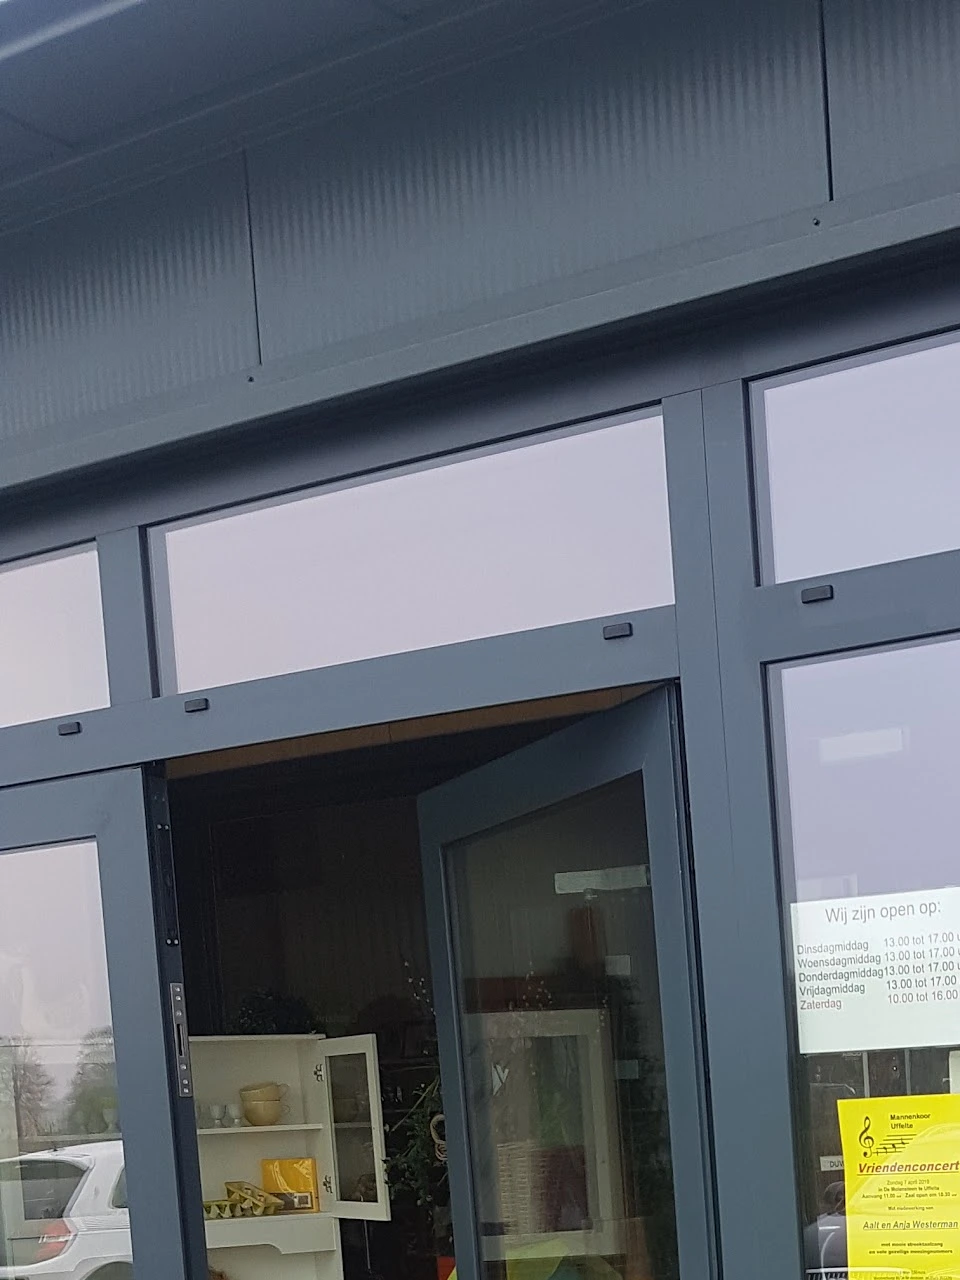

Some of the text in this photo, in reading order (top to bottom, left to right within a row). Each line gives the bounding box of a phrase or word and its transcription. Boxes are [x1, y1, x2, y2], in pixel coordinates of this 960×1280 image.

[825, 901, 941, 925] Wij zijn open op:
[797, 941, 869, 955] Dinsdagmiddag
[884, 936, 909, 948] 13.00
[913, 935, 925, 946] tot
[928, 932, 954, 944] 17.00
[798, 954, 881, 969] Woensdagmiddag
[885, 951, 910, 962] 13.00
[914, 949, 925, 960] tot
[929, 947, 955, 958] 17.00
[799, 968, 884, 983] Donderdagmiddag
[884, 965, 910, 976] 13.00
[913, 964, 925, 974] tot
[928, 961, 954, 973] 17.00
[799, 983, 865, 997] Vrijdagmiddag
[887, 979, 912, 990] 13.00
[915, 978, 927, 988] tot
[931, 975, 957, 987] 17.00
[800, 999, 842, 1010] Zaterdag
[888, 993, 914, 1004] 10.00
[916, 991, 929, 1002] tot
[932, 989, 958, 1001] 16.00
[859, 1161, 960, 1173] Vriendenconcert
[863, 1221, 879, 1229] Aalt
[893, 1221, 911, 1230] Anja
